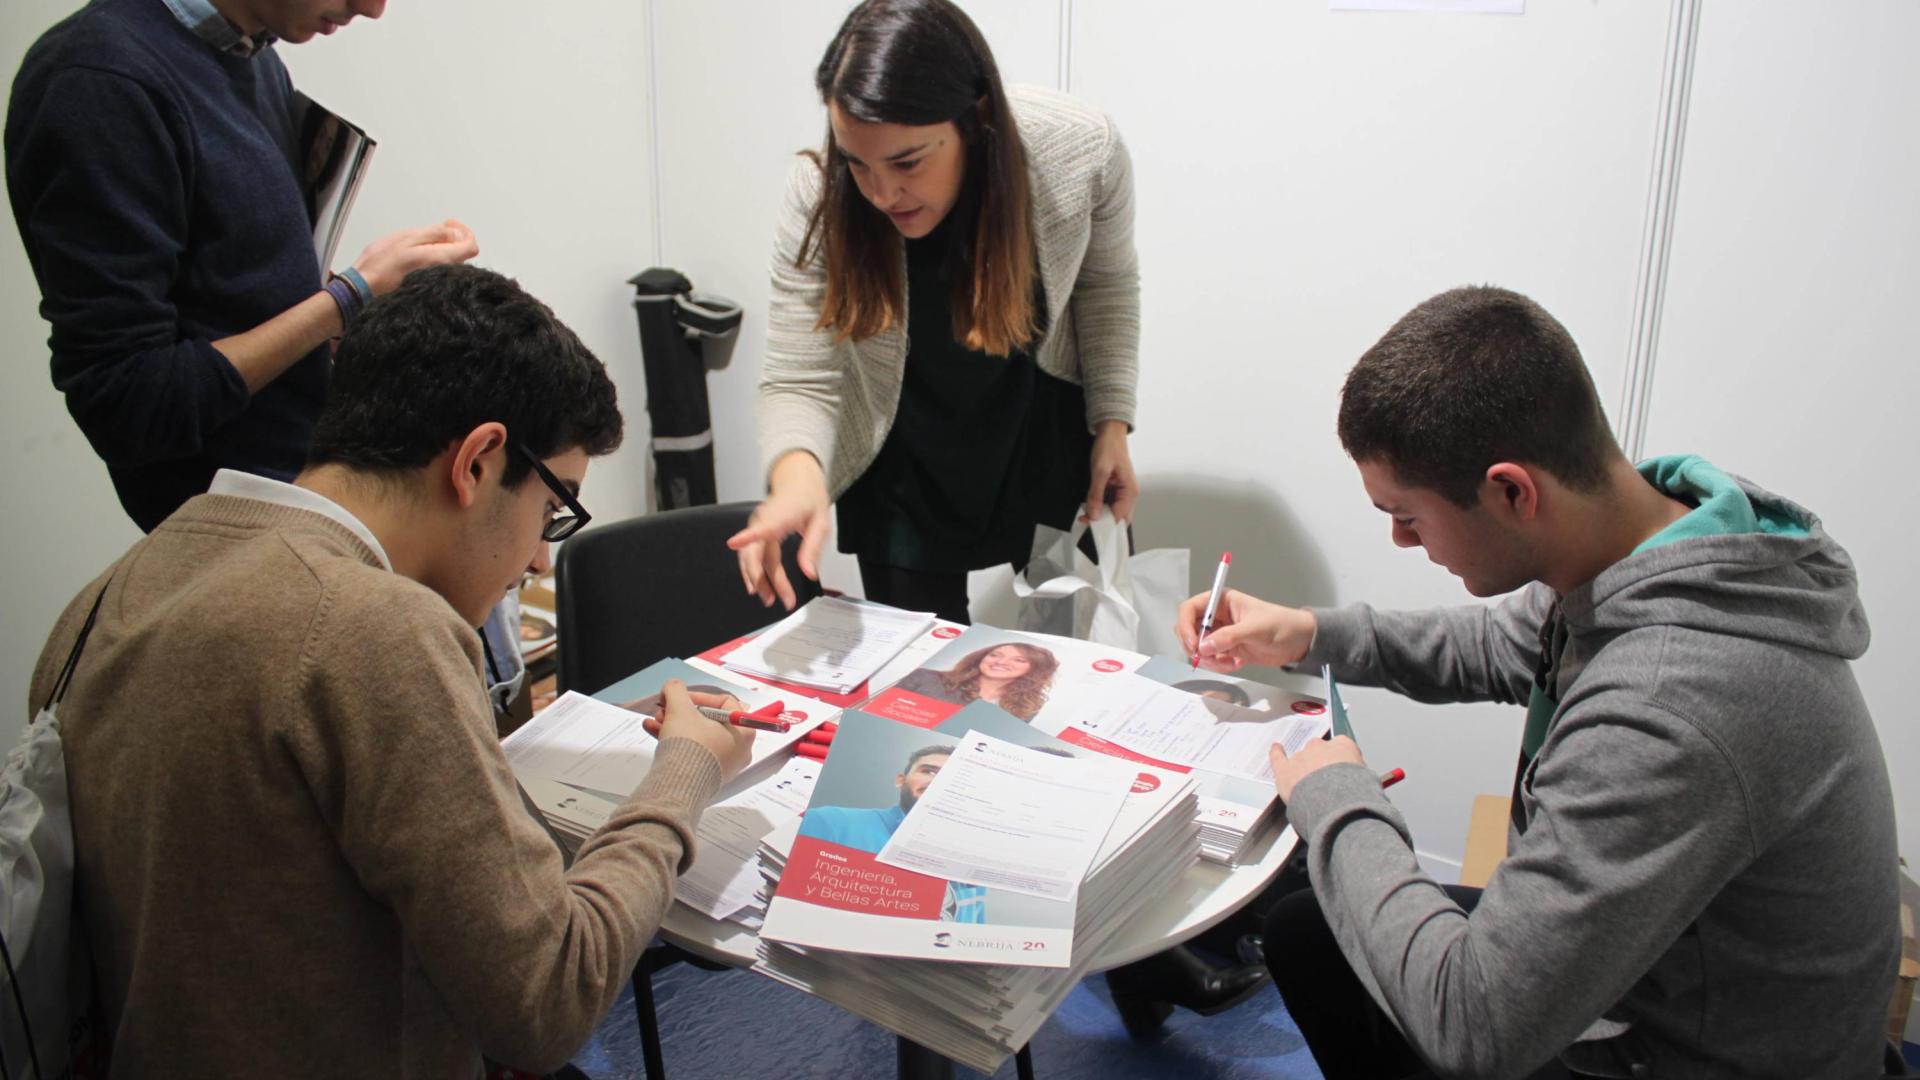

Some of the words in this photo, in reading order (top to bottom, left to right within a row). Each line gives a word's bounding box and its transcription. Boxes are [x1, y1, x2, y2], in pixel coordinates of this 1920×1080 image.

[819, 850, 848, 863] Grados
[809, 871, 913, 899] Arquitectura
[814, 858, 898, 886] Ingeniería,
[804, 884, 817, 897] y
[820, 886, 870, 906] Bellas
[873, 897, 921, 912] Artes
[959, 940, 1015, 951] NEBRIJA
